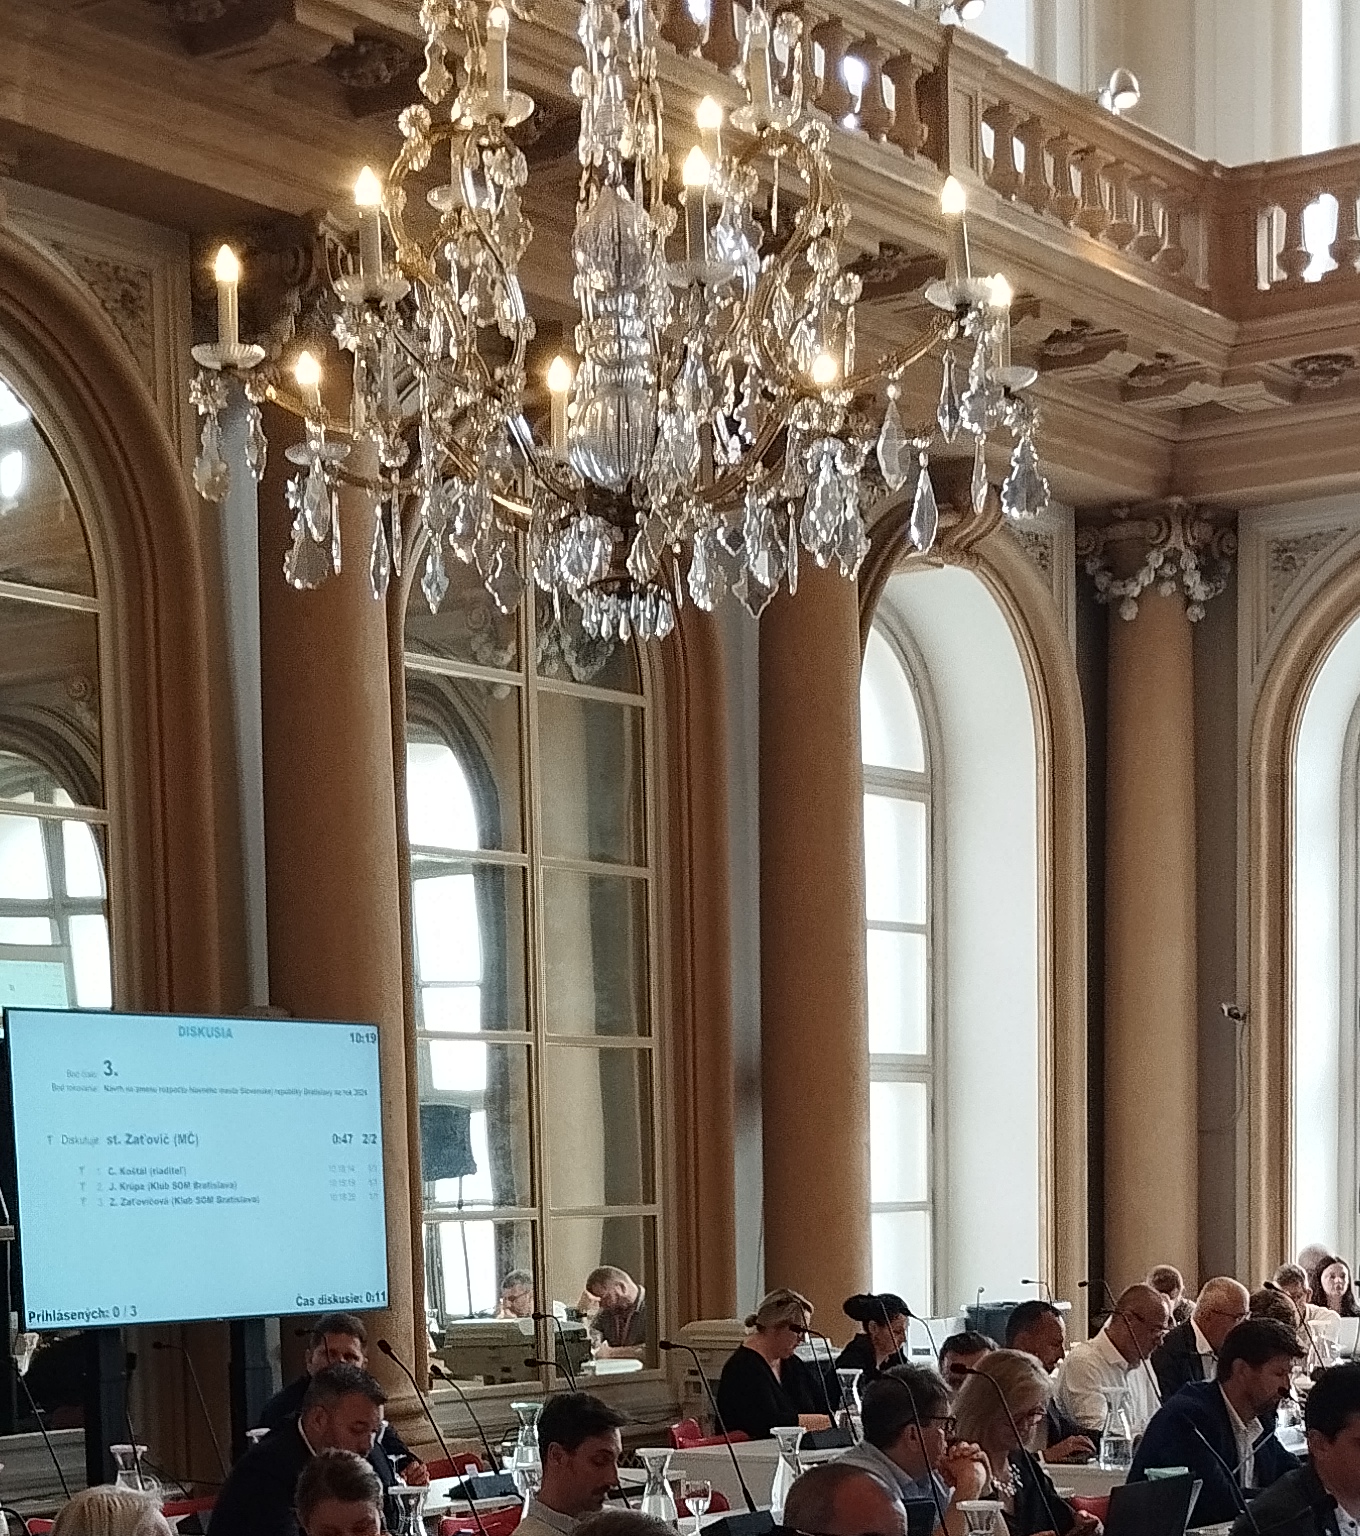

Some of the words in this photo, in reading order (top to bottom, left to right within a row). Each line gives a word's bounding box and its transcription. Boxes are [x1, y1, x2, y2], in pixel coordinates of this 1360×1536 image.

[178, 1025, 233, 1039] DISKUSIA
[350, 1032, 377, 1044] 10:19
[103, 1059, 118, 1076] 3.
[332, 1133, 353, 1144] 0:47
[296, 1293, 315, 1306] Čas
[318, 1292, 363, 1305] diskusie:
[28, 1307, 110, 1322] Prihlásených:
[129, 1305, 138, 1317] 3
